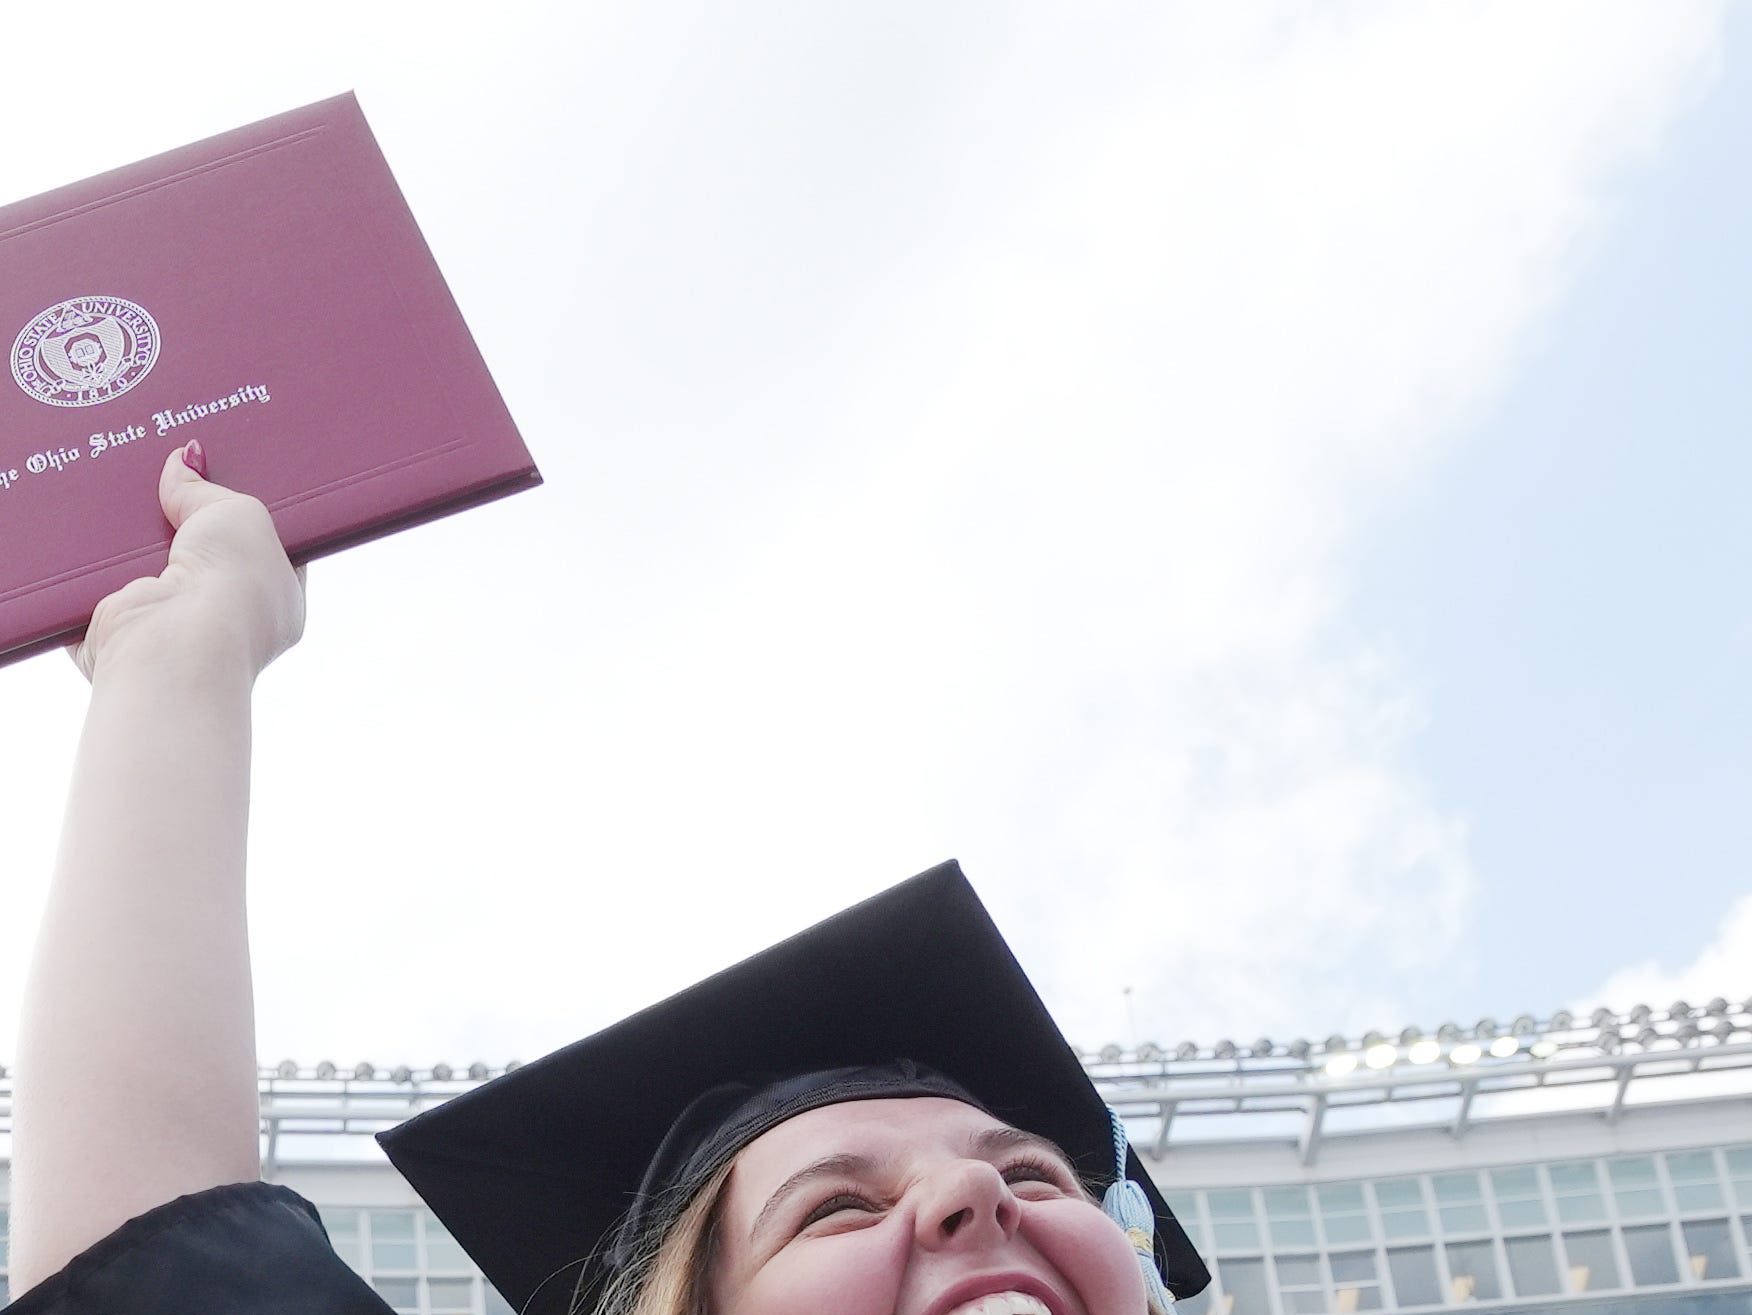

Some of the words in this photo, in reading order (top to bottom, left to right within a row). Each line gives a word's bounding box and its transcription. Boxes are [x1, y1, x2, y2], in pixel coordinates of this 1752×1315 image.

[24, 313, 59, 346] STATE
[77, 378, 128, 401] 1870
[25, 447, 80, 474] Ohio
[88, 424, 147, 458] State
[151, 384, 271, 436] University
